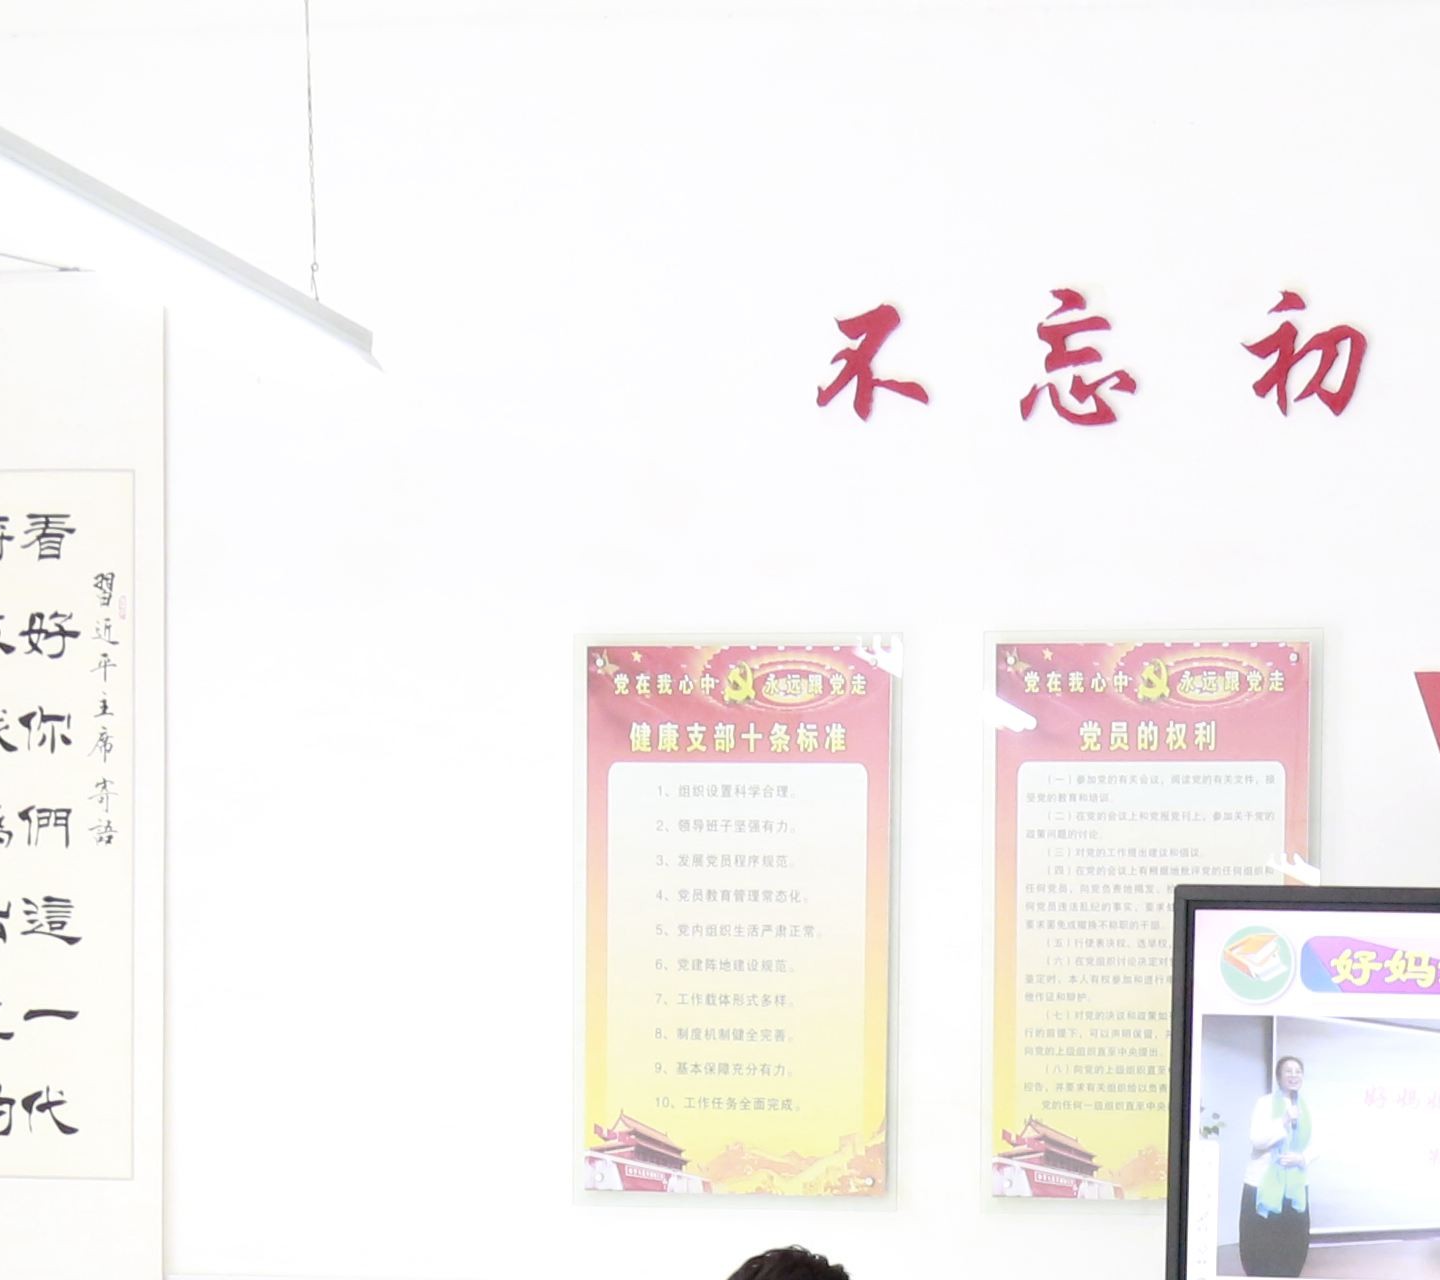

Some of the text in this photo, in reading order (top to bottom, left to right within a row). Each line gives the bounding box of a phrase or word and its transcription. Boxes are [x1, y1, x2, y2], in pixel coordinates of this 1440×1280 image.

[614, 673, 868, 696] 党在我心中 永远跟党走
[1024, 670, 1285, 694] 党在我心中 永远跟党走
[629, 722, 847, 753] 健康支部十条标准
[1079, 719, 1218, 752] 党员的权利
